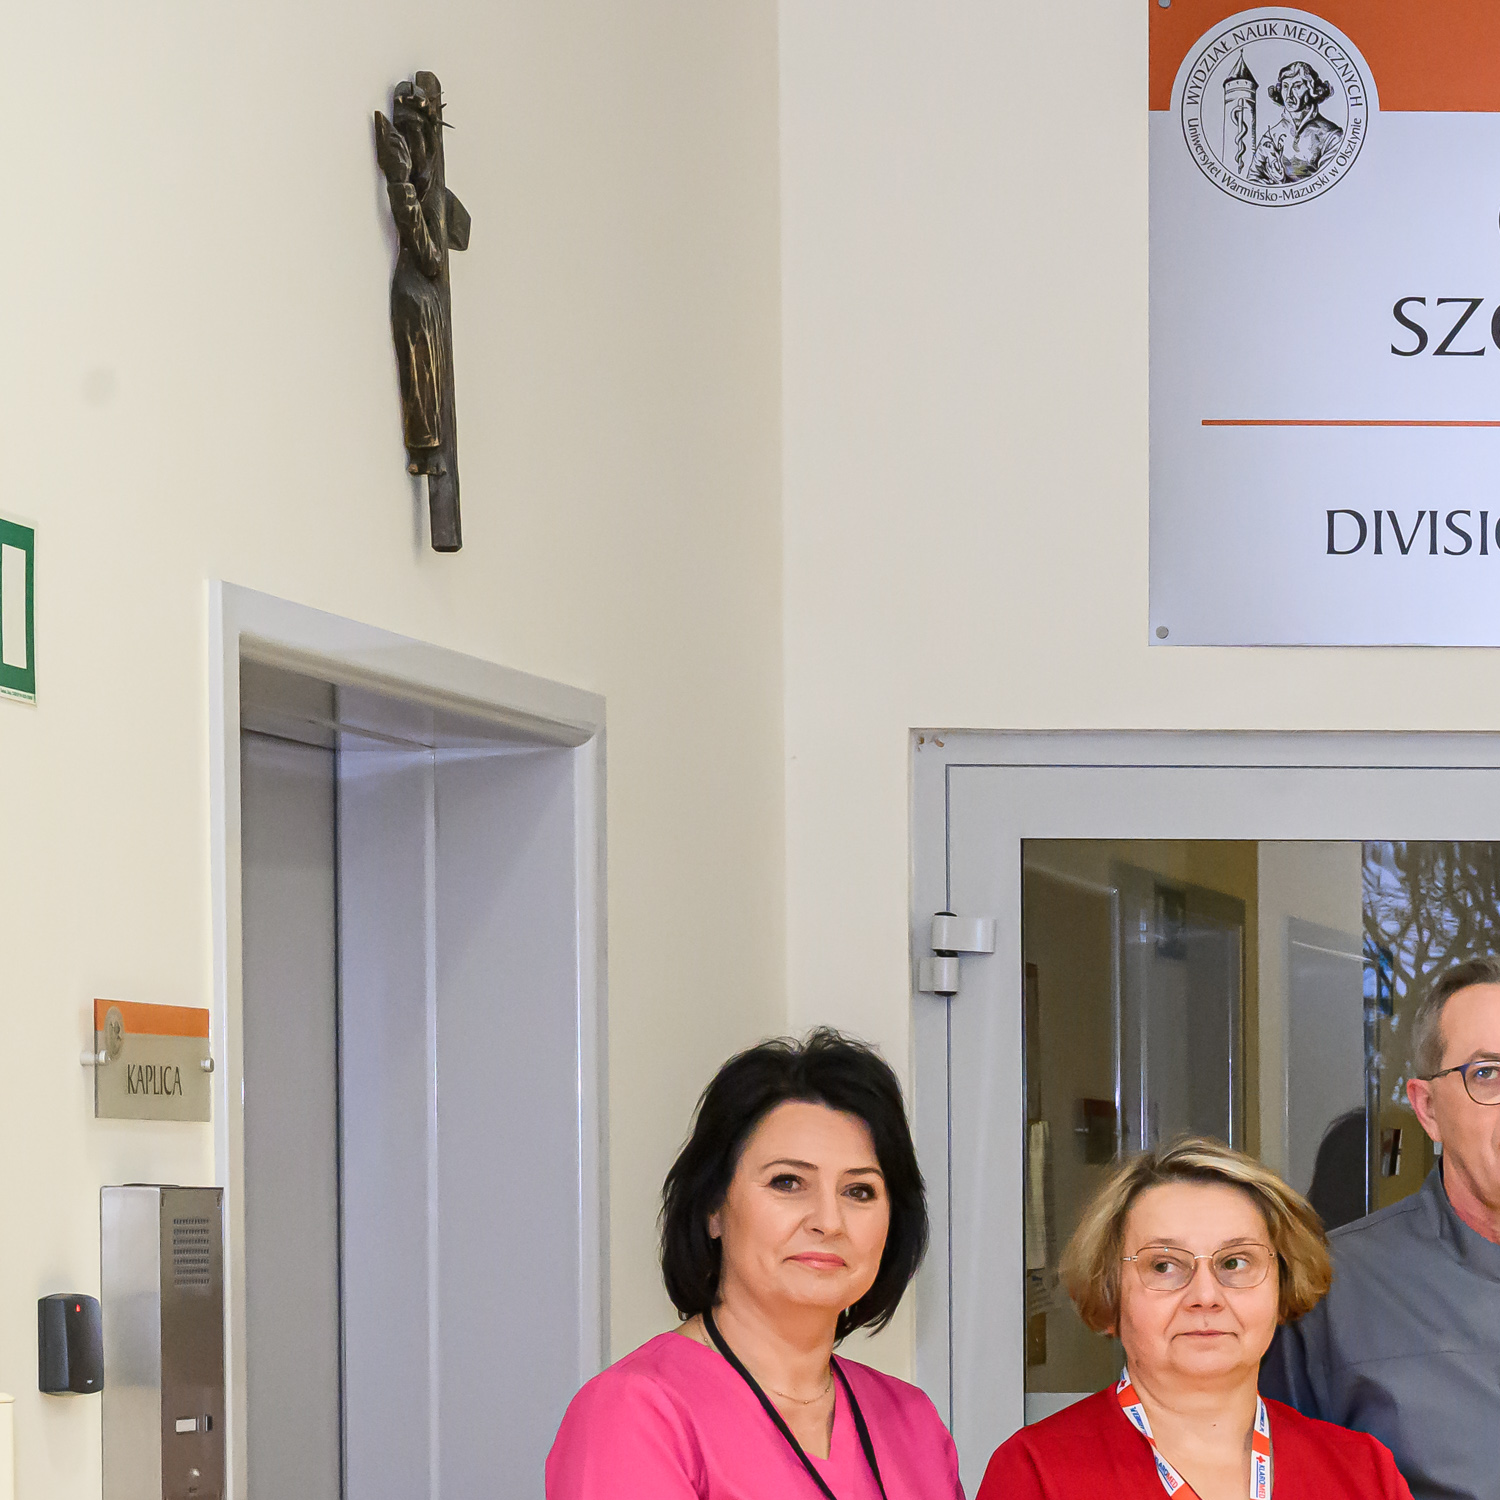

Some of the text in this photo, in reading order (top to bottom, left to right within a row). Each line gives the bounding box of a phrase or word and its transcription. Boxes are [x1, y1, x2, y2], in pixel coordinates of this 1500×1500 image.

[1186, 23, 1363, 107] WYDZIAŁ NAUK MEDYCZNYCH
[1188, 118, 1222, 178] Uniwersytet
[1221, 174, 1331, 201] Warmińsko-Mazurski
[1335, 118, 1362, 167] Olsztynie
[127, 1064, 183, 1096] KAPLICA
